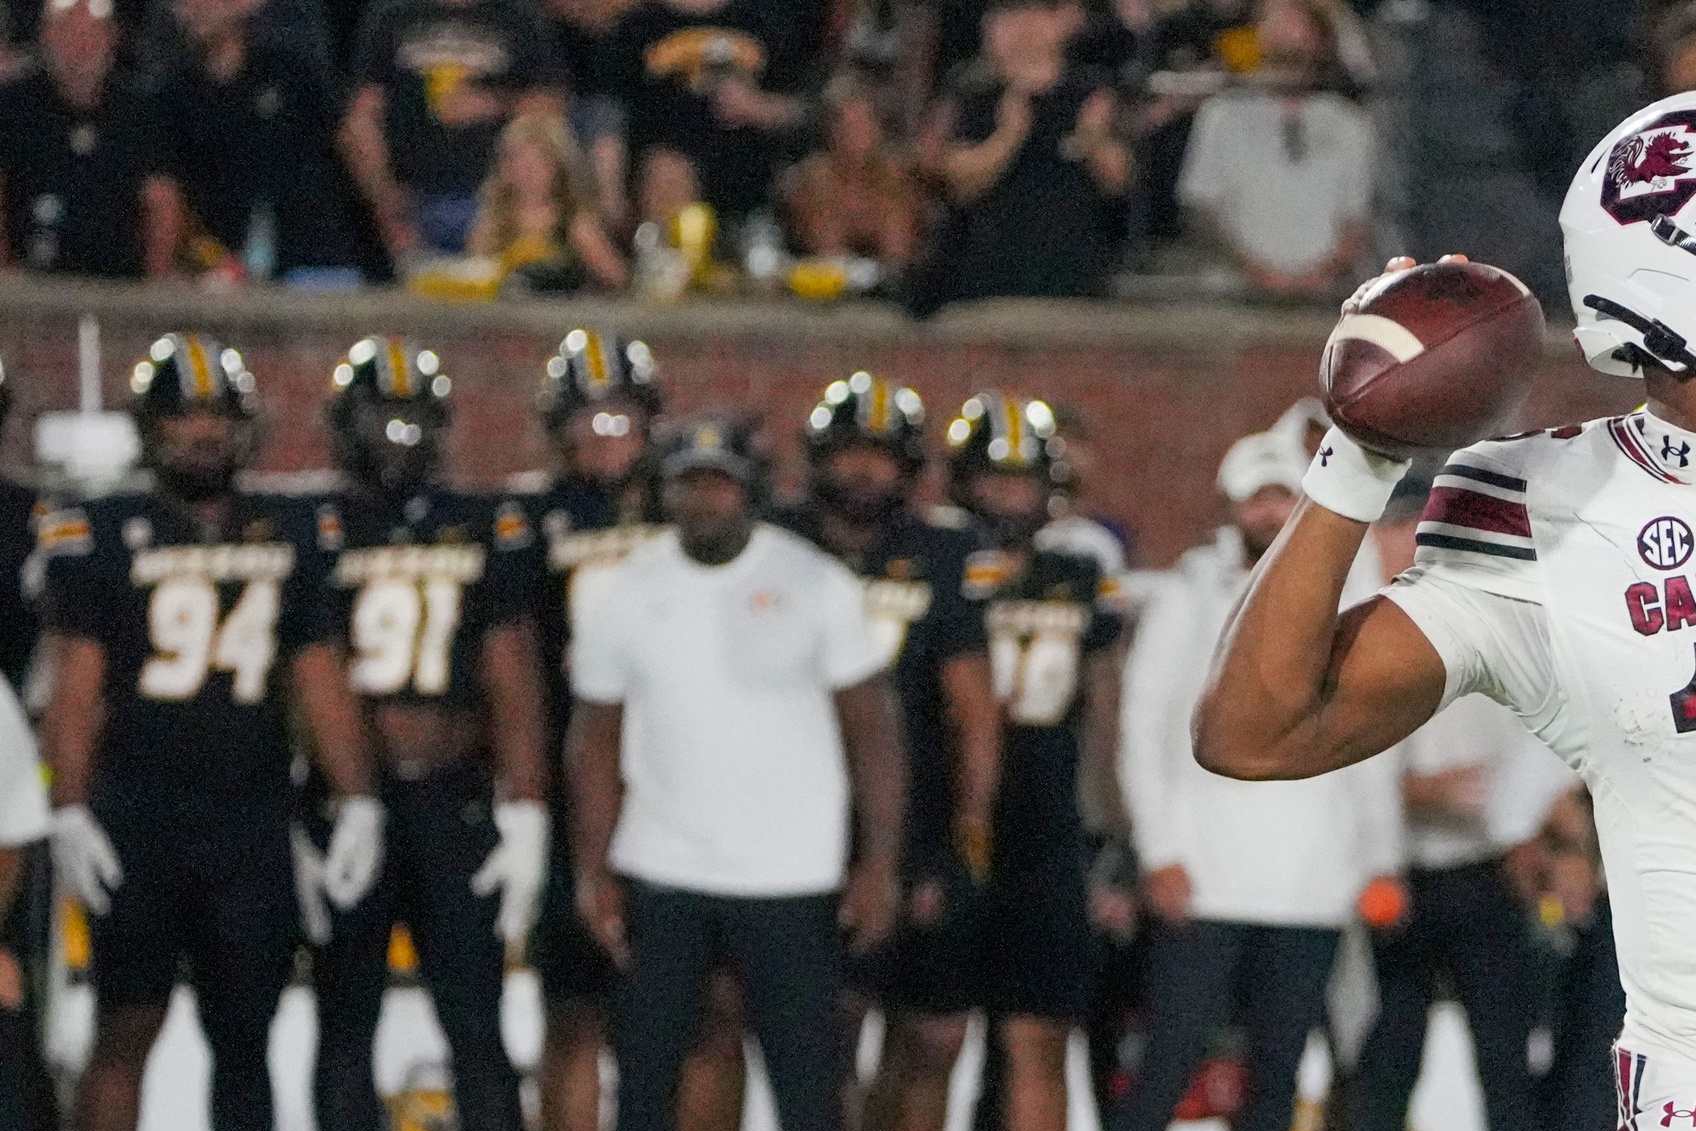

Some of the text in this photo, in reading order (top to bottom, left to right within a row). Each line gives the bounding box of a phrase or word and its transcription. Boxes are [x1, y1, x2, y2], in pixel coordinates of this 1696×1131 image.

[1640, 518, 1692, 569] SEC
[139, 576, 281, 703] 94
[350, 580, 463, 696] 91
